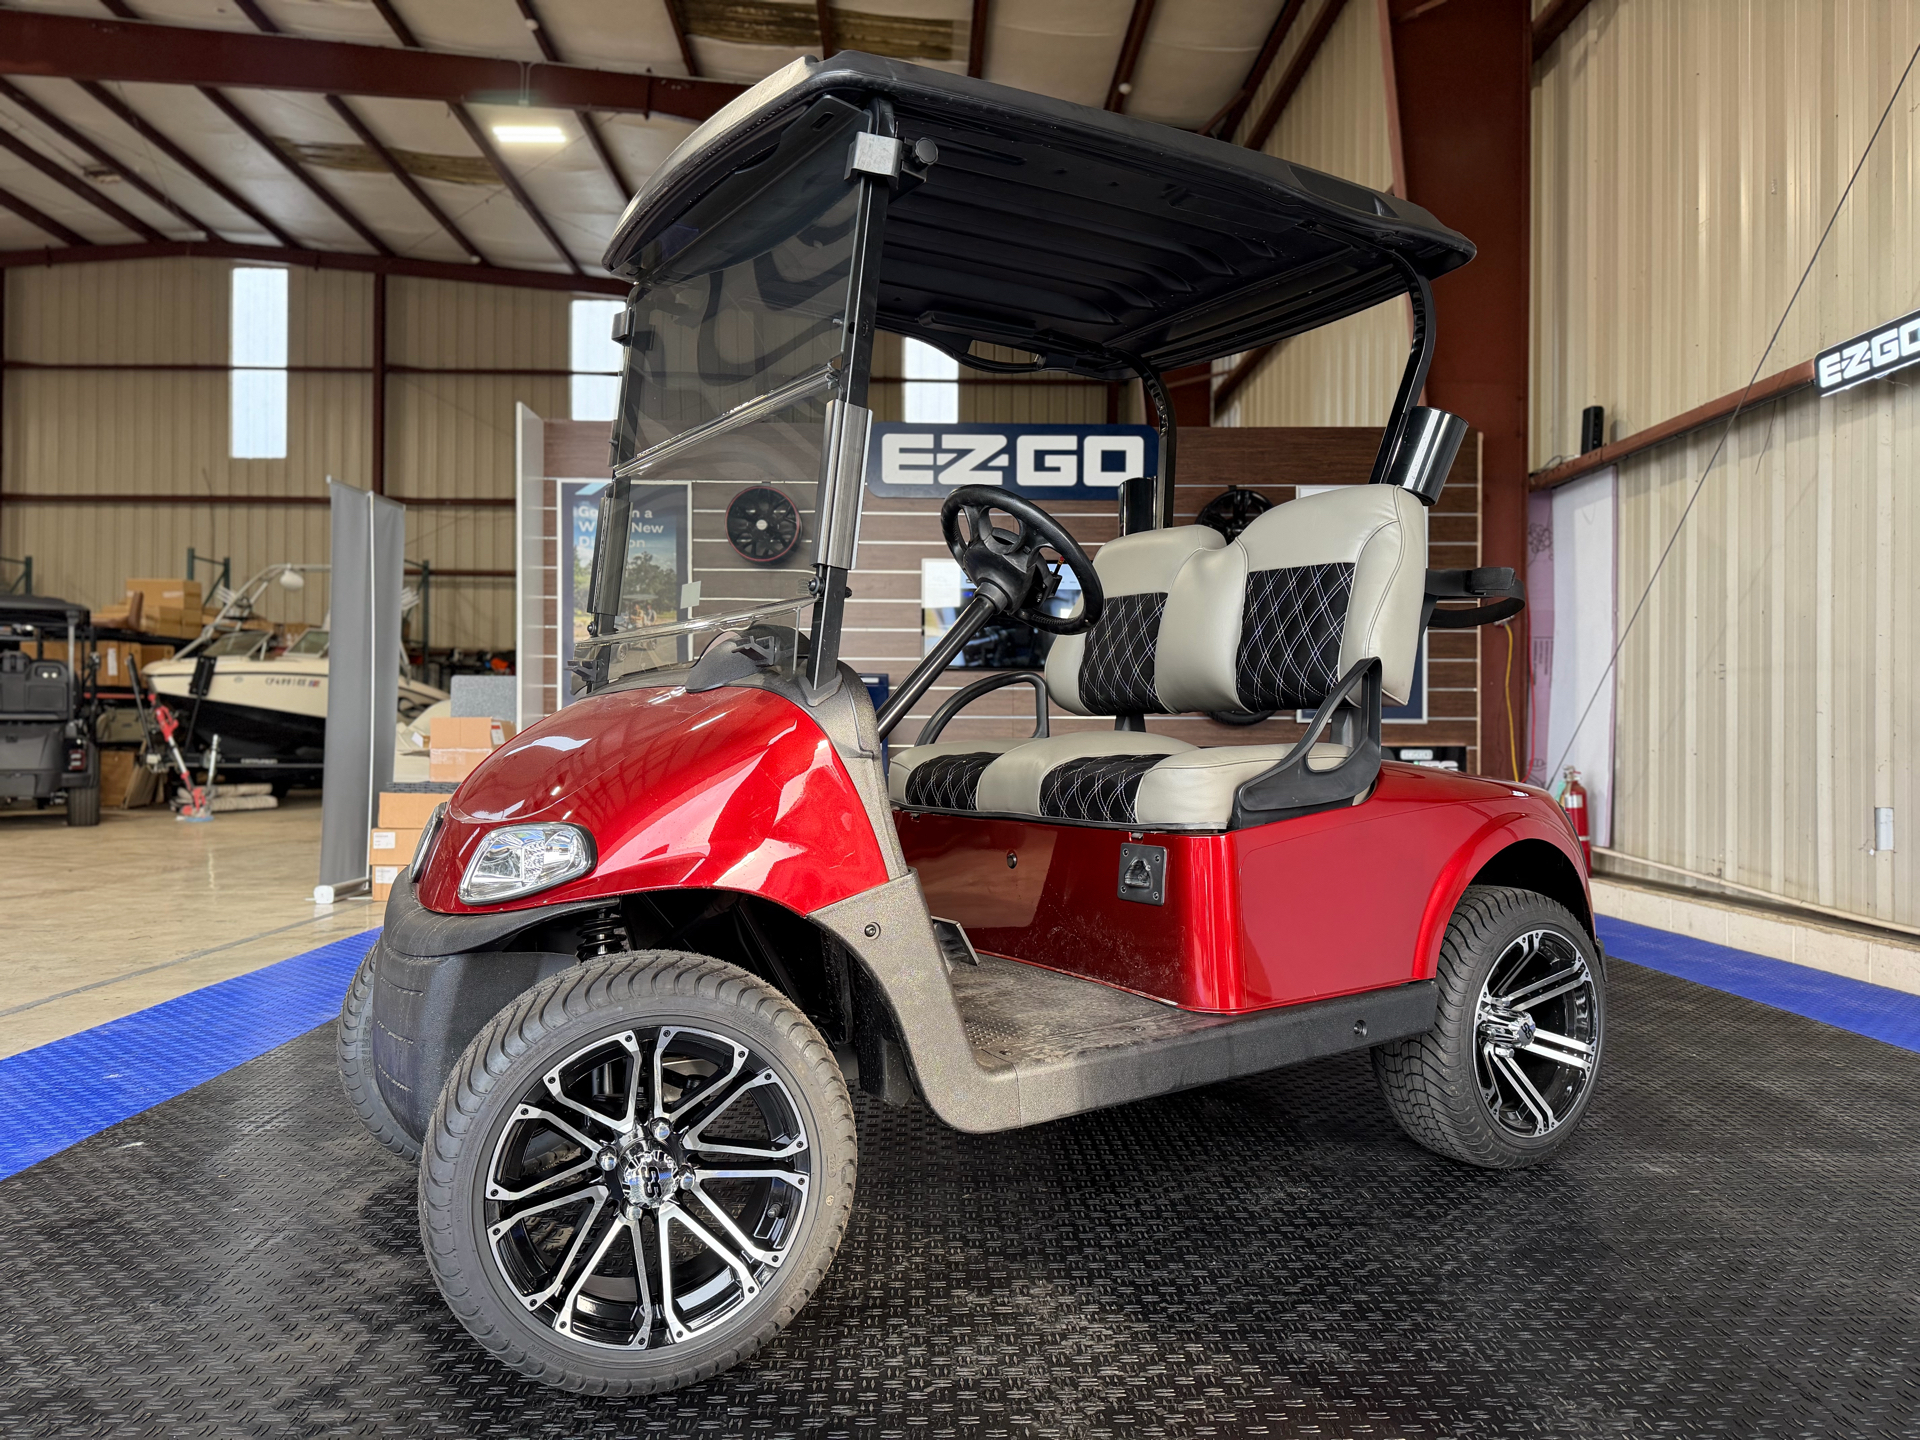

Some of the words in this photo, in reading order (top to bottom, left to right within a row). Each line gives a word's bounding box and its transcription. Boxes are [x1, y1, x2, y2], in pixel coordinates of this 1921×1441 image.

[631, 521, 664, 533] New
[729, 1009, 774, 1038] INNOVA
[526, 1342, 578, 1371] DRIVER
